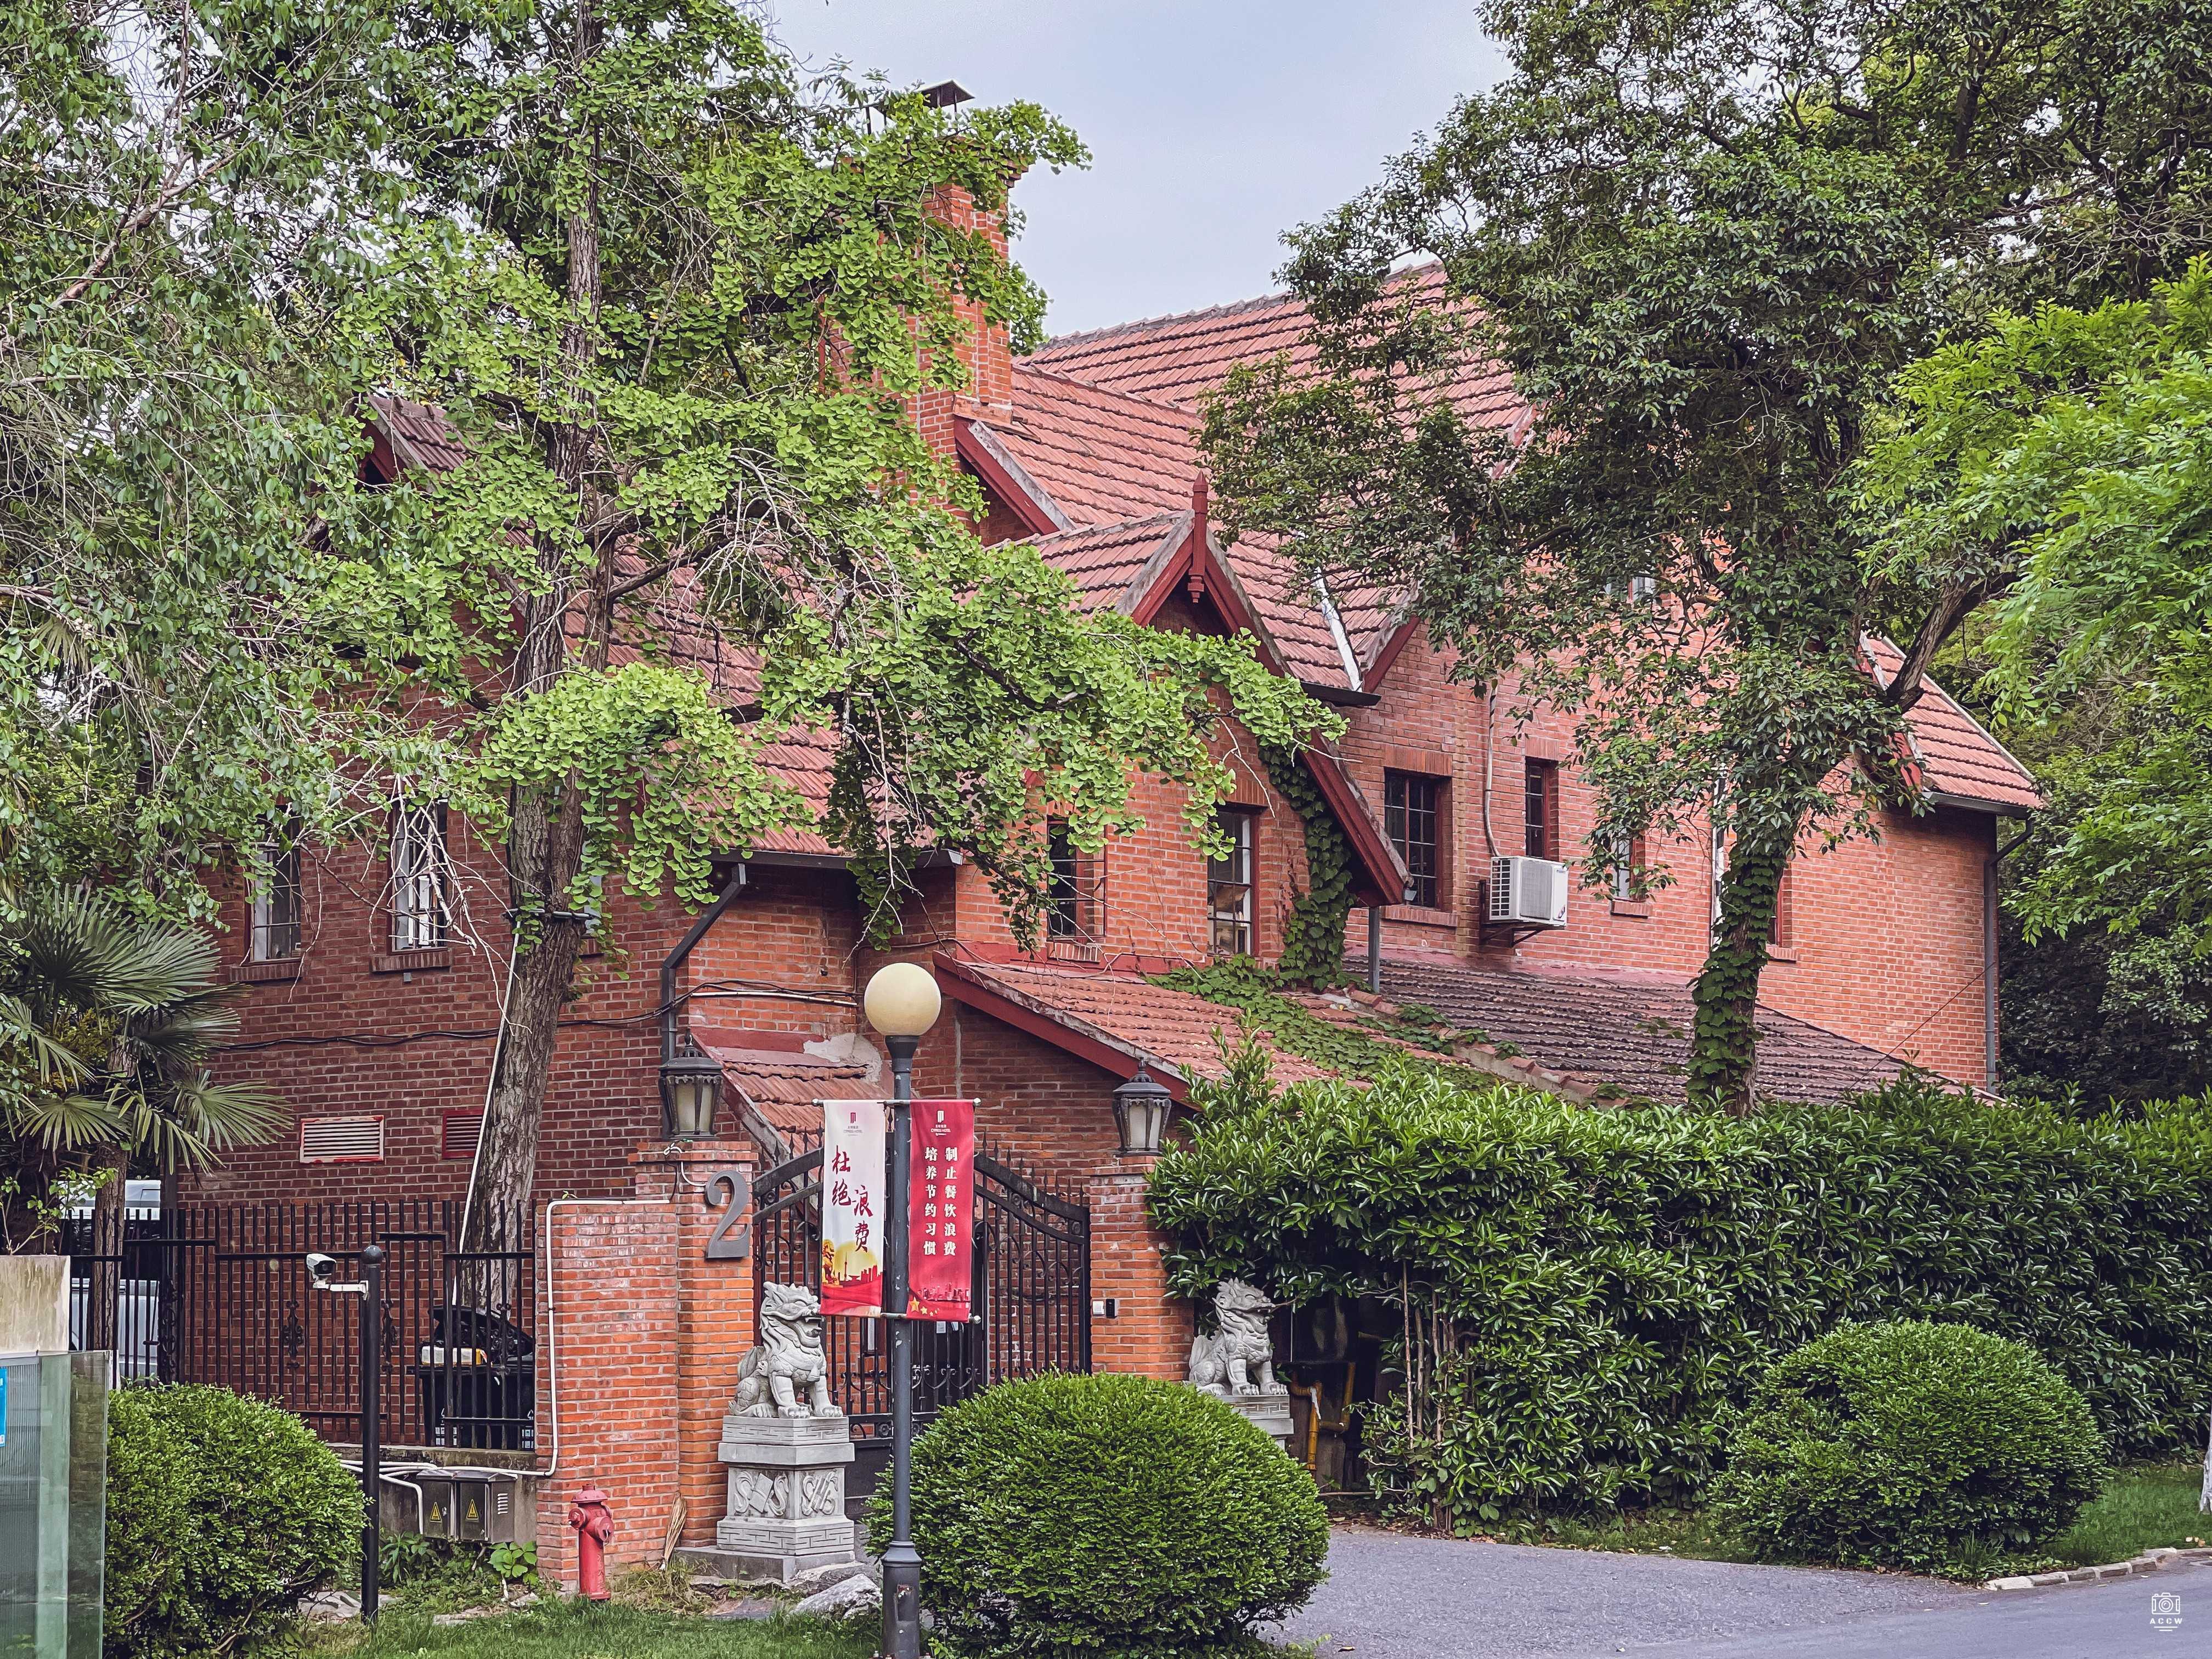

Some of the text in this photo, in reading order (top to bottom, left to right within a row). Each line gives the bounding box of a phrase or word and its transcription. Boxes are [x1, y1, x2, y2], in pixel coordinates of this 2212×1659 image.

[706, 1170, 750, 1258] 2
[831, 1145, 851, 1206] 杜绝
[852, 1184, 873, 1253] 浪费
[923, 1147, 938, 1256] 培养节约习惯
[944, 1147, 958, 1256] 制止餐饮浪费
